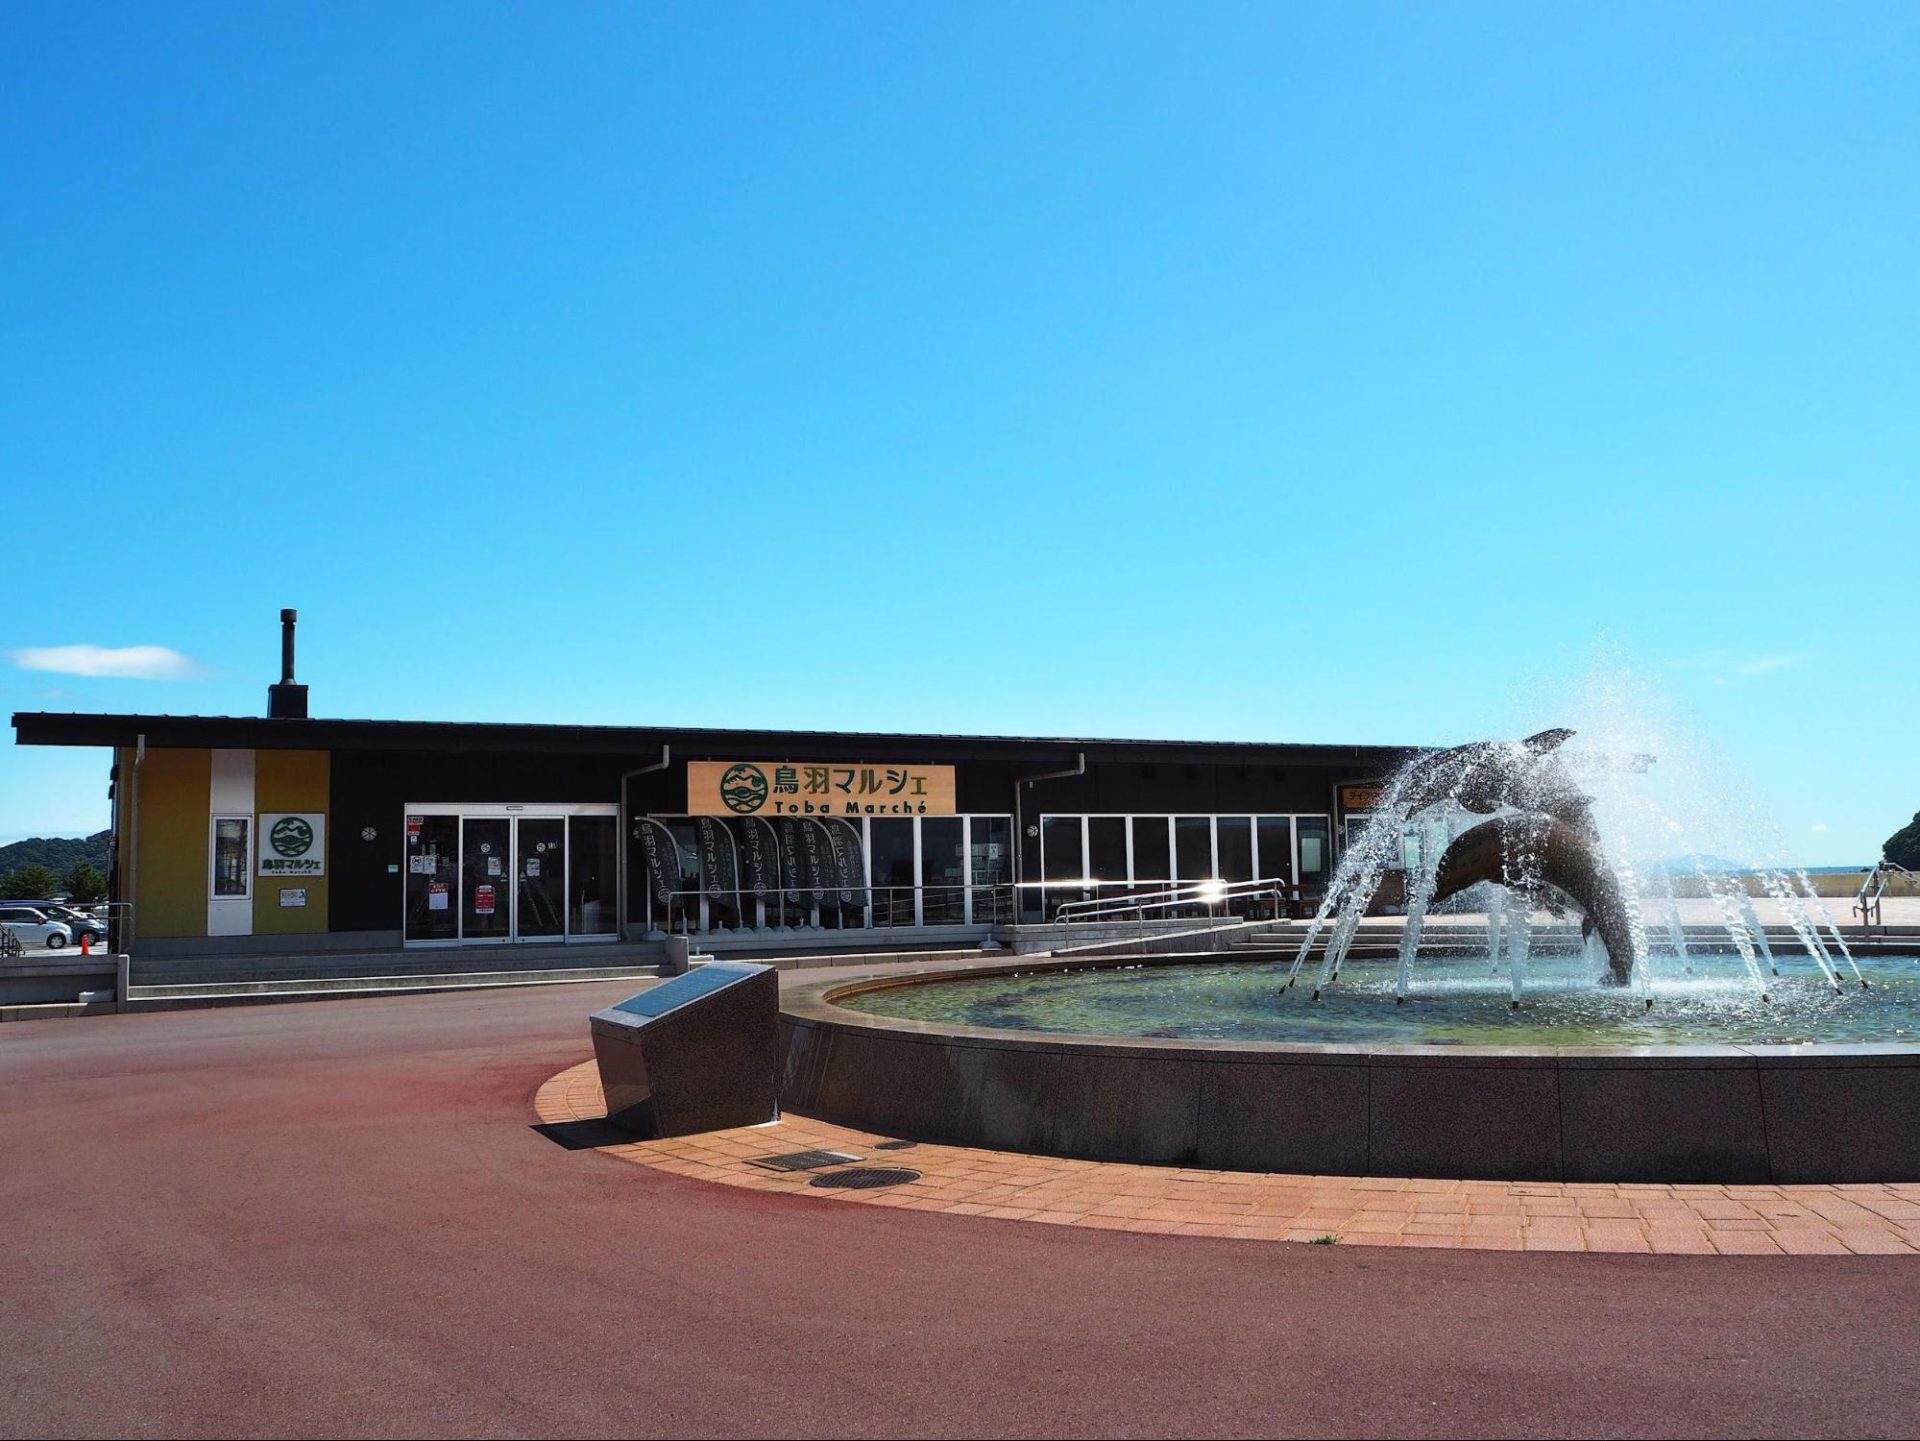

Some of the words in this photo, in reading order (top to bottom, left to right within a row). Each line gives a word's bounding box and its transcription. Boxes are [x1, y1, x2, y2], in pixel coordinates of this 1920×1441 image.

[773, 766, 928, 795] 鳥羽マルシェ
[775, 801, 831, 814] Toba
[846, 800, 927, 814] Marché
[262, 858, 321, 870] 鳥羽マルシェ
[641, 823, 665, 888] 鳥羽マルシェ
[701, 818, 719, 883] 鳥羽マルシェ
[802, 821, 820, 885] 鳥羽マルシェ
